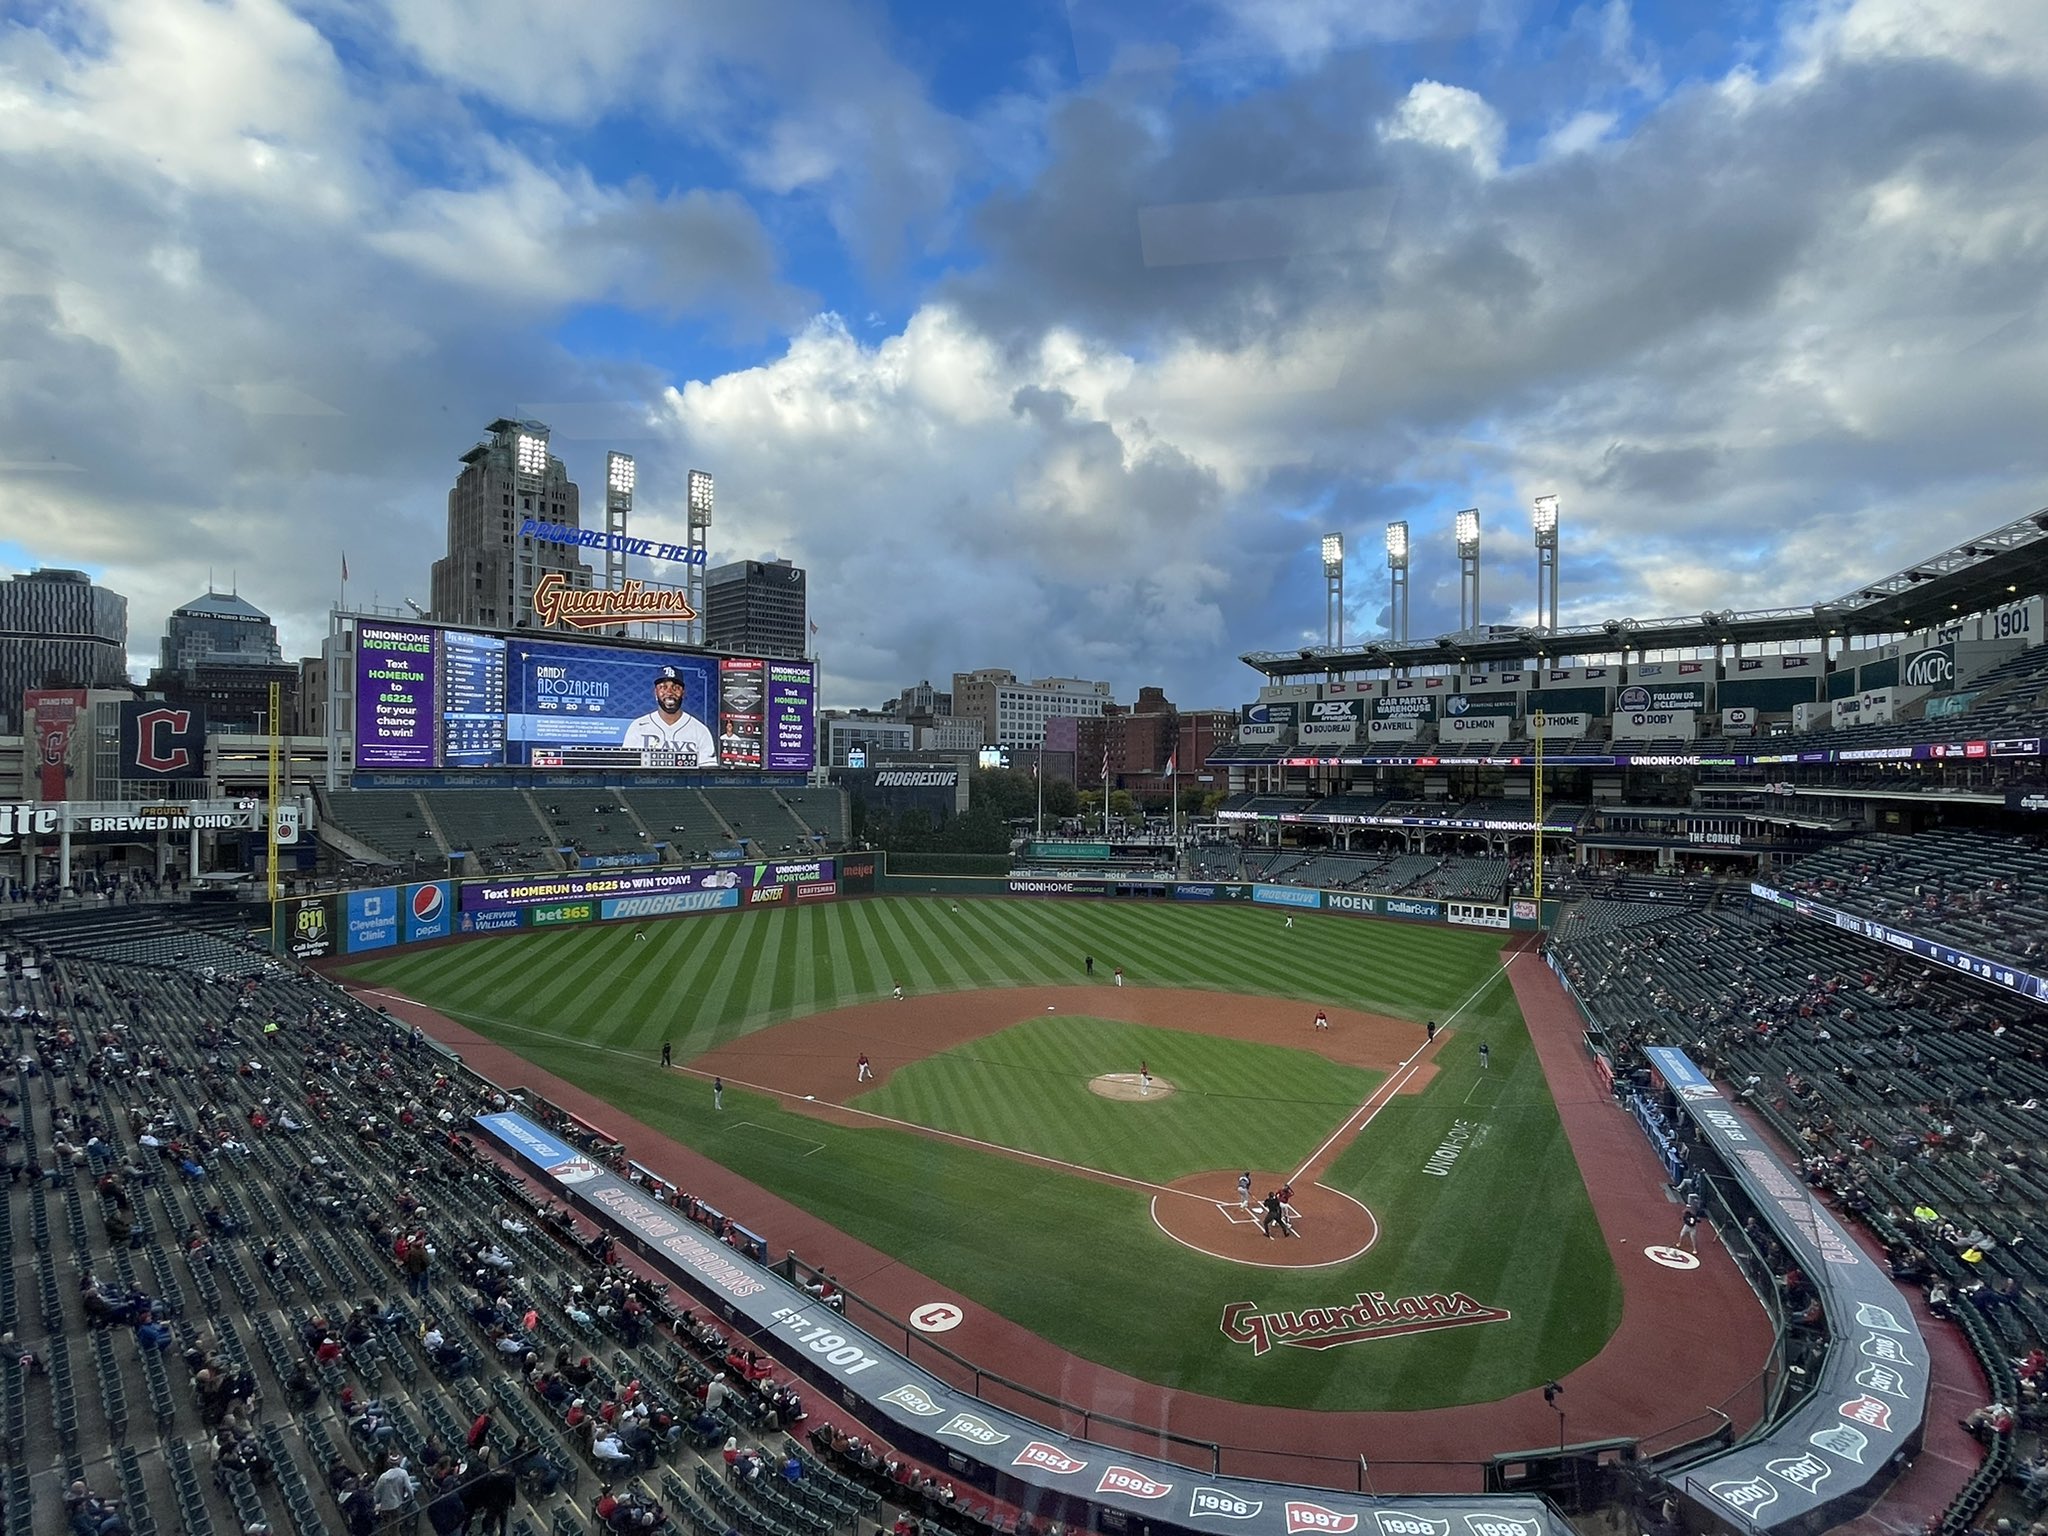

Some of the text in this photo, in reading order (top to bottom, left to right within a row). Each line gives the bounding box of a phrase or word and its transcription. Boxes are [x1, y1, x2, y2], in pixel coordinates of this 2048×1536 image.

[518, 519, 708, 566] PROGRESSIVE FIELD
[534, 574, 697, 628] Guardians
[186, 610, 211, 618] FIFTH
[211, 613, 238, 621] THIRD
[1994, 607, 2029, 638] 1901
[362, 629, 430, 643] UNIONHOME
[363, 639, 430, 653] MORTGAGE
[385, 659, 409, 669] Text
[368, 670, 424, 681] HOMERUN
[537, 666, 566, 679] RANDY
[771, 674, 811, 684] MORTGAGE
[390, 683, 403, 692] to
[537, 678, 609, 697] AROZARENA
[784, 688, 798, 696] Text
[379, 693, 414, 703] 86225
[774, 697, 807, 705] HOMERUN
[1379, 697, 1429, 706] CAR PARTS
[1653, 691, 1695, 701] FOLLOW US
[376, 704, 417, 716] for your
[1312, 701, 1354, 716] DEX
[1377, 704, 1431, 714] WAREHOUSE
[1653, 700, 1703, 710] @CLEinspires
[376, 716, 415, 726] chance
[1548, 716, 1580, 726] THOME
[1647, 714, 1674, 724] DOBY
[1732, 712, 1745, 720] 20
[779, 722, 803, 732] for your
[1252, 726, 1275, 734] FELLER
[1313, 724, 1351, 733] BOUDREAU
[1382, 722, 1414, 730] AVERILL
[1466, 720, 1495, 729] LEMON
[378, 728, 414, 737] to win!
[779, 732, 803, 740] chance
[136, 708, 191, 773] C
[780, 740, 787, 748] to
[1630, 755, 1736, 766] UNIONHOME MORTGAGE
[875, 771, 958, 787] PROGRESSIVE
[0, 805, 57, 842] ite
[90, 814, 232, 833] BREWED IN OHIO
[1689, 832, 1741, 845] THE CORNER
[776, 863, 820, 874] UNIONHOME
[843, 863, 874, 877] meijer
[776, 872, 820, 883] MORTGAGE
[482, 889, 509, 900] Text
[511, 884, 569, 898] HOMERUN
[572, 883, 583, 893] to
[585, 880, 618, 892] 86225
[619, 879, 631, 889] to
[632, 878, 654, 888] WIN
[655, 875, 691, 886] TODAY!
[800, 886, 834, 895] CRAFTSMAN
[1009, 881, 1074, 892] UNIONHOME
[1176, 885, 1216, 897] FirstEnergy
[751, 887, 783, 903] BLASTER
[1256, 889, 1316, 904] PROGRESSIVE
[613, 890, 724, 917] PROGRESSIVE
[1329, 894, 1373, 911] MOEN
[1387, 901, 1437, 916] DollarBank
[1515, 902, 1533, 912] drug
[298, 909, 323, 930] 811
[477, 911, 517, 921] SHERWIN
[535, 905, 589, 921] bet365
[350, 915, 395, 931] Cleveland
[1472, 918, 1501, 926] CLIFFS
[359, 930, 385, 941] Clinic
[415, 924, 441, 938] pepsi
[293, 941, 329, 952] Call before
[528, 1143, 560, 1157] FIELD
[593, 1187, 766, 1298] CLEVELAND GUARDIANS
[920, 1307, 955, 1327] C
[1220, 1291, 1511, 1356] Guardians
[771, 1307, 879, 1375] EST. 1901
[1876, 1337, 1898, 1361] 2018
[1869, 1366, 1895, 1391] 2017
[895, 1389, 930, 1412] 1920
[1854, 1401, 1885, 1424] 2016
[952, 1418, 995, 1441] 1948
[1825, 1426, 1858, 1451] 2013
[1026, 1447, 1070, 1471] 1954
[1780, 1458, 1824, 1483] 2007
[1107, 1472, 1156, 1495] 1995
[1724, 1483, 1771, 1507] 2001
[1197, 1493, 1248, 1515] 1996
[1290, 1508, 1342, 1529] 1997
[1381, 1518, 1435, 1536] 1998
